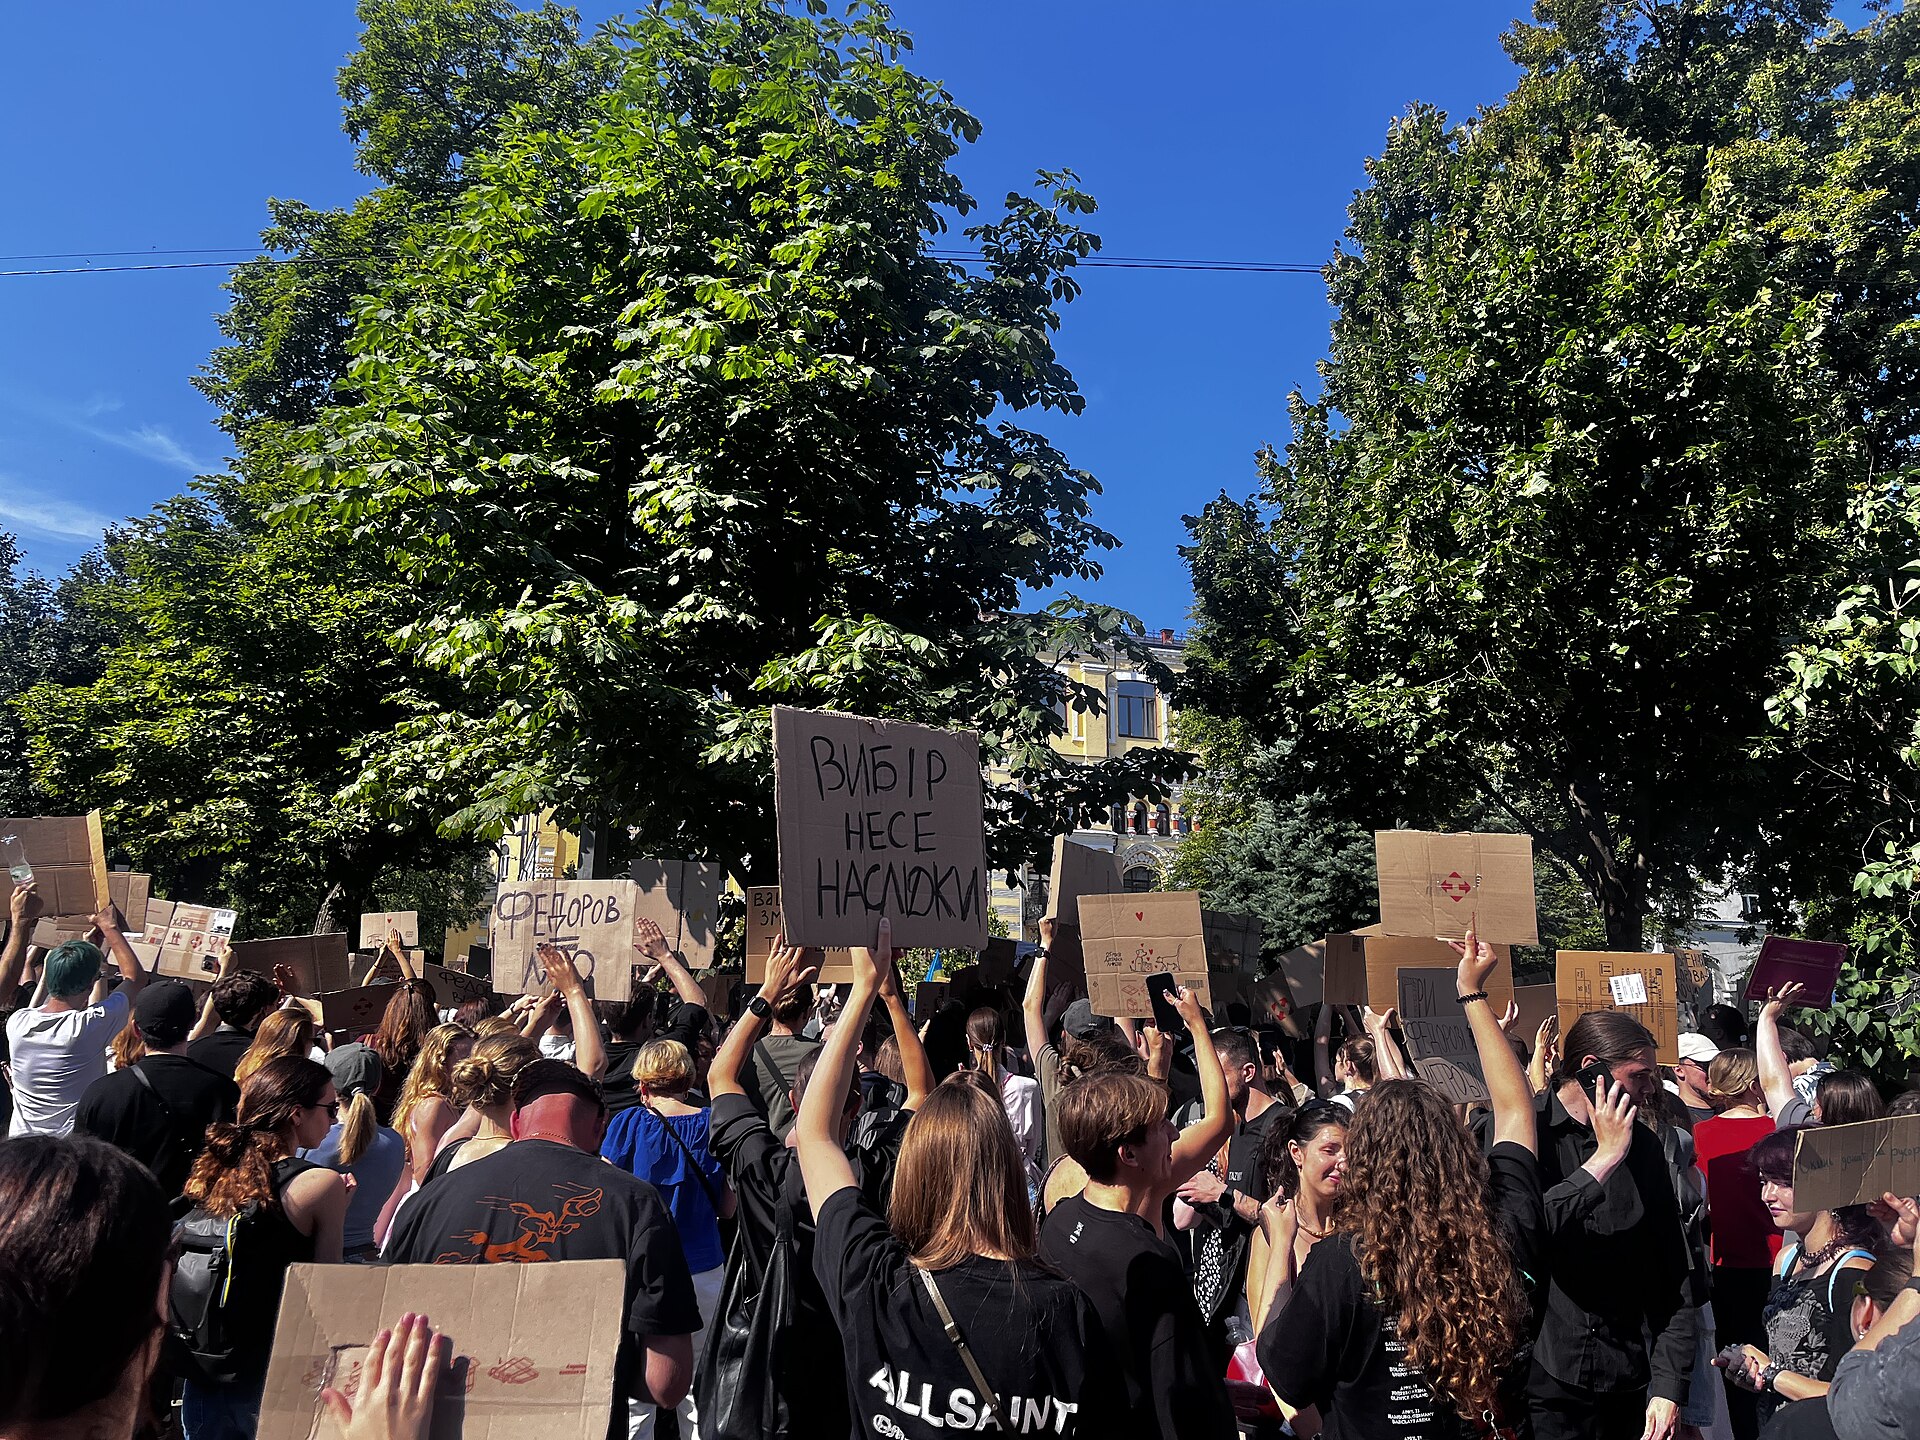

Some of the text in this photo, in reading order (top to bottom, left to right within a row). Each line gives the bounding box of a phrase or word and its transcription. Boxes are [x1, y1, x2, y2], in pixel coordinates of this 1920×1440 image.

[810, 735, 948, 801] ВИБІР
[845, 811, 937, 854] НЕСЕ
[496, 890, 621, 940] ФЕДОРОВ
[817, 857, 982, 932] НАСЛІДКИ
[869, 1361, 1079, 1437] ALLSAINT
